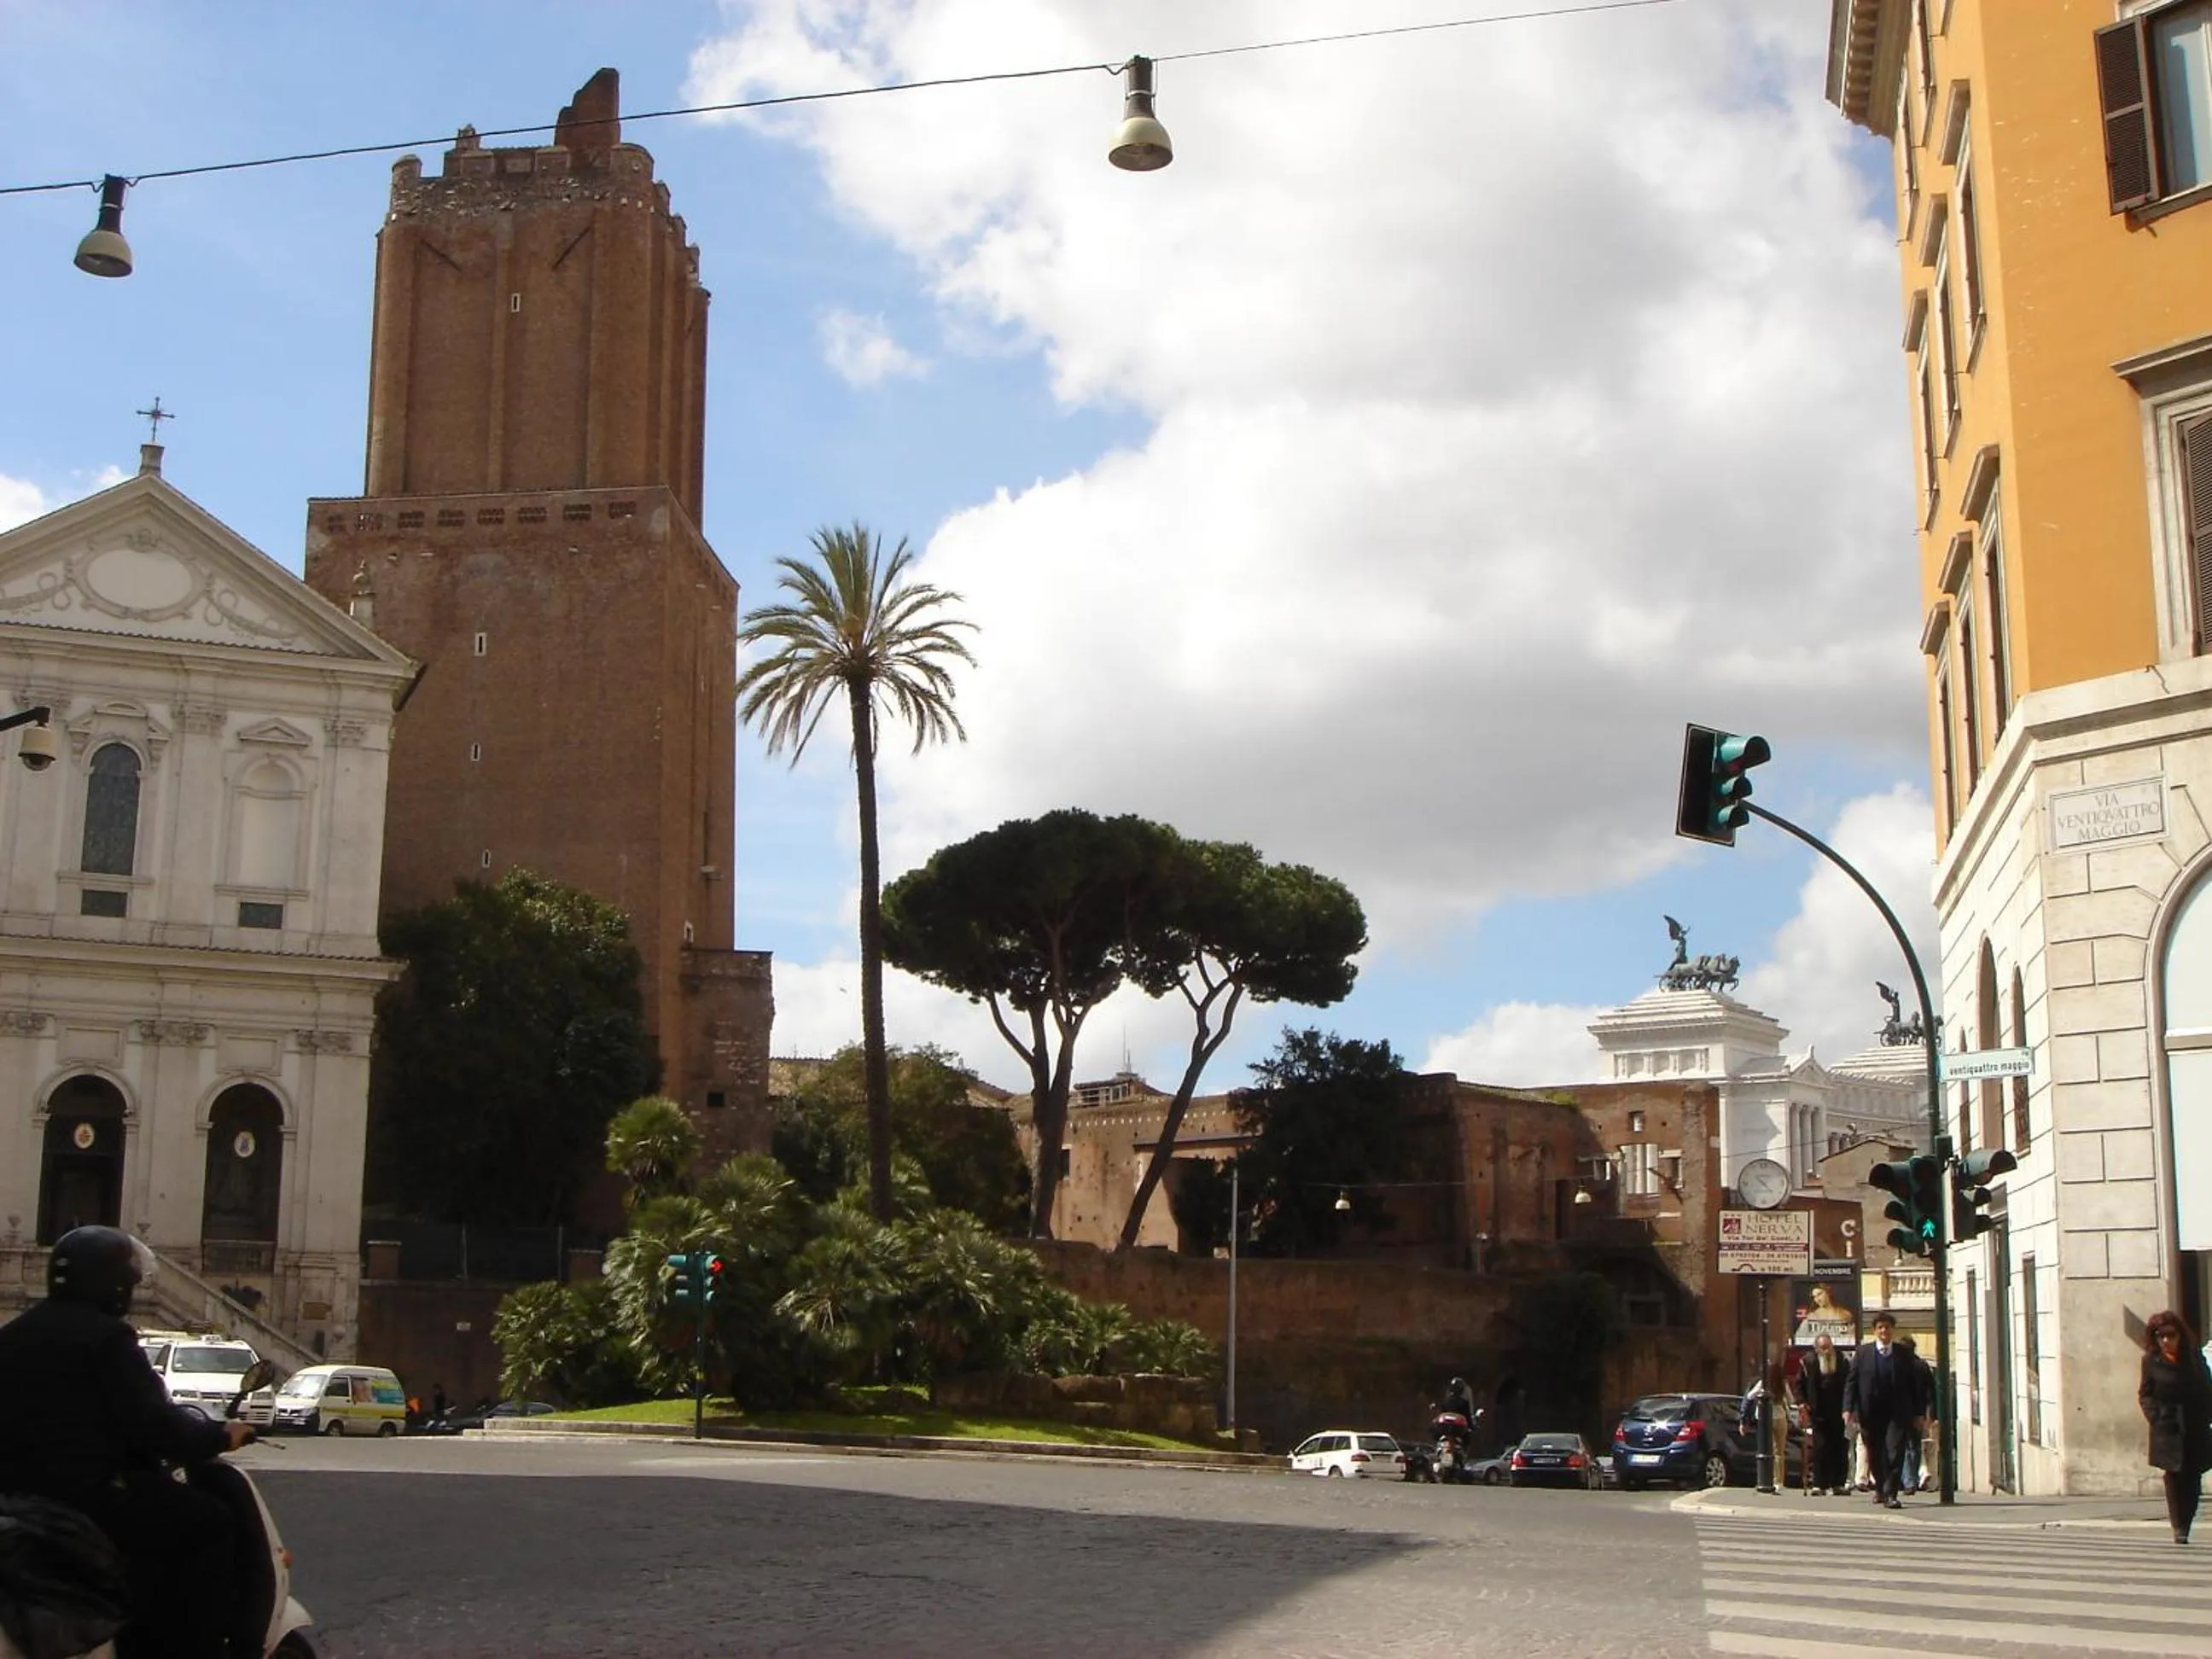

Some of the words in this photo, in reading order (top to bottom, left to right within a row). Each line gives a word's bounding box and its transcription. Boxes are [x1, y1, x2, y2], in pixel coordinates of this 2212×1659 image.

[2093, 792, 2119, 806] VIA
[2078, 820, 2141, 841] MAGGIO
[1949, 1062, 1999, 1076] ventiquattro
[2000, 1060, 2030, 1072] maggio
[1747, 1214, 1801, 1224] HOTEL
[1744, 1225, 1804, 1235] NERVA
